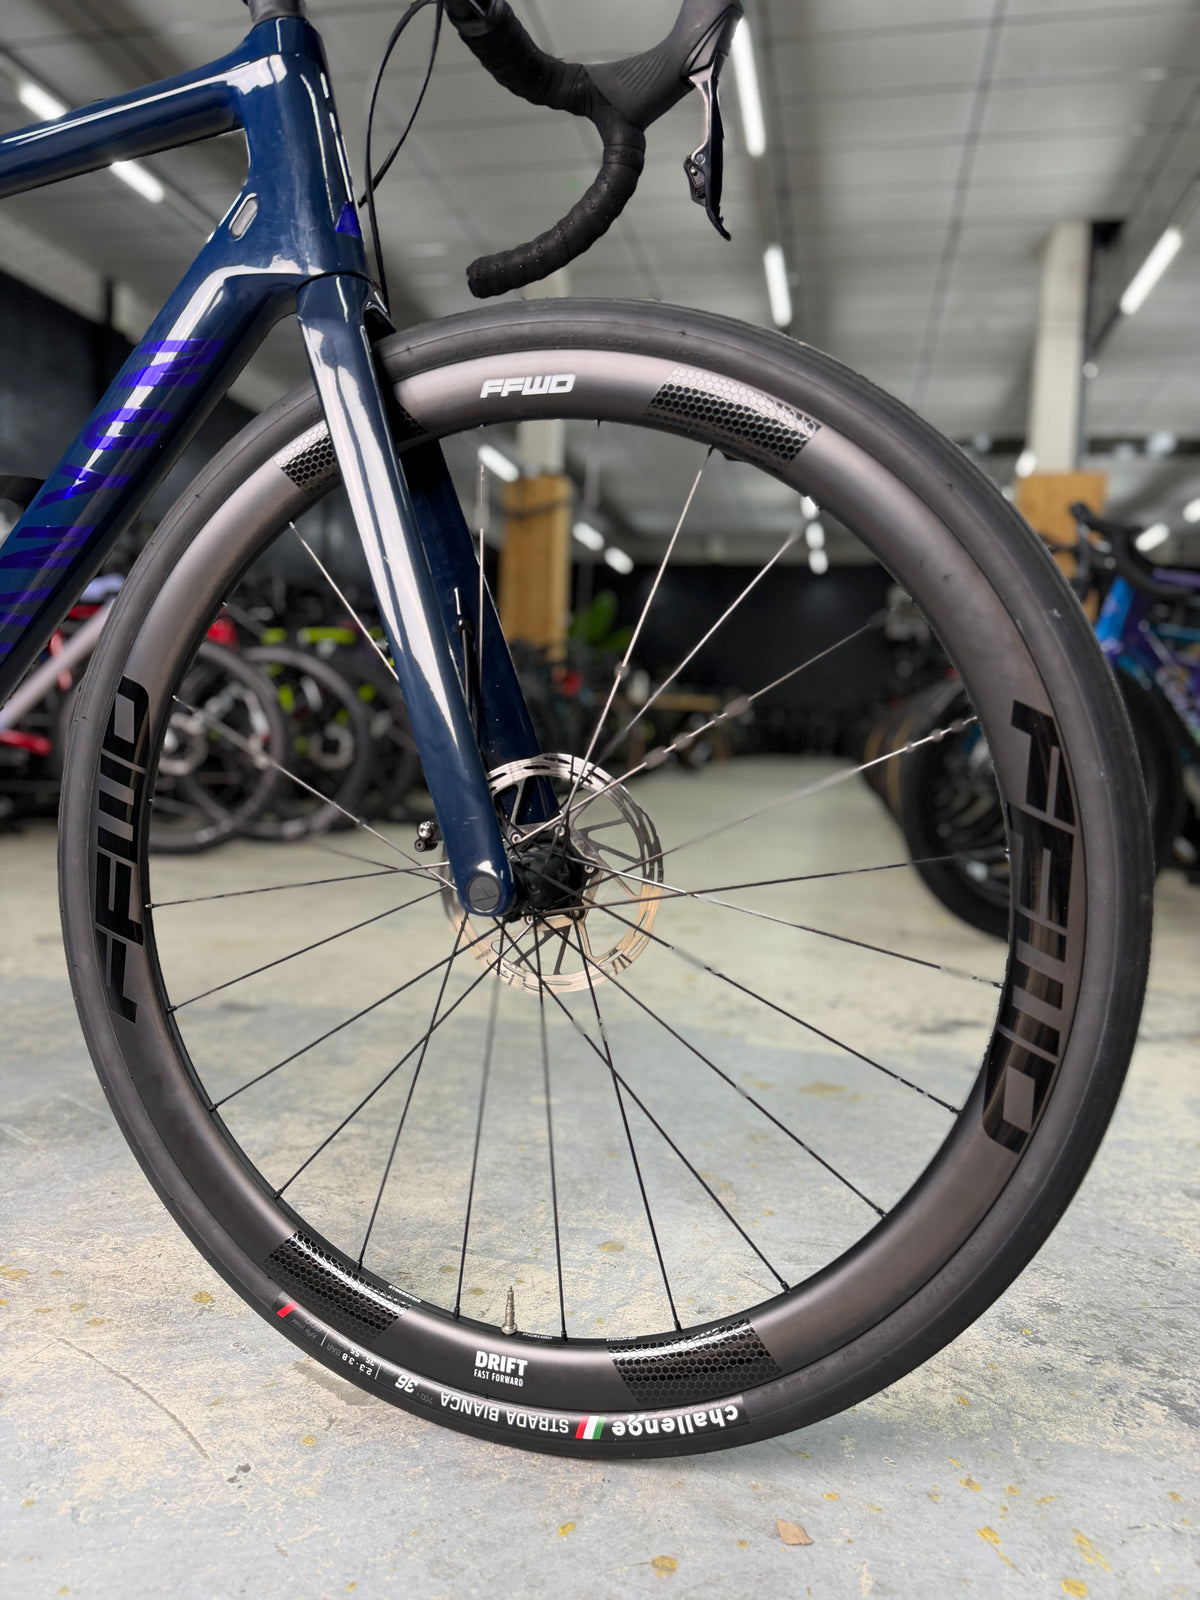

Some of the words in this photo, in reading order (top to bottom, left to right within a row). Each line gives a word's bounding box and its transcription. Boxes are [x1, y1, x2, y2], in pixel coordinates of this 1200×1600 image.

[480, 374, 576, 399] FFWD
[0, 338, 225, 665] ANYON
[95, 675, 150, 1024] FFWD
[982, 700, 1076, 1154] FFWD
[475, 1350, 528, 1376] DRIFT
[394, 1374, 419, 1393] 36
[473, 1368, 490, 1380] FAST
[491, 1372, 524, 1387] FORWARD
[440, 1391, 500, 1422] BIANCA
[611, 1405, 739, 1436] challenge
[506, 1410, 569, 1434] STRADA
